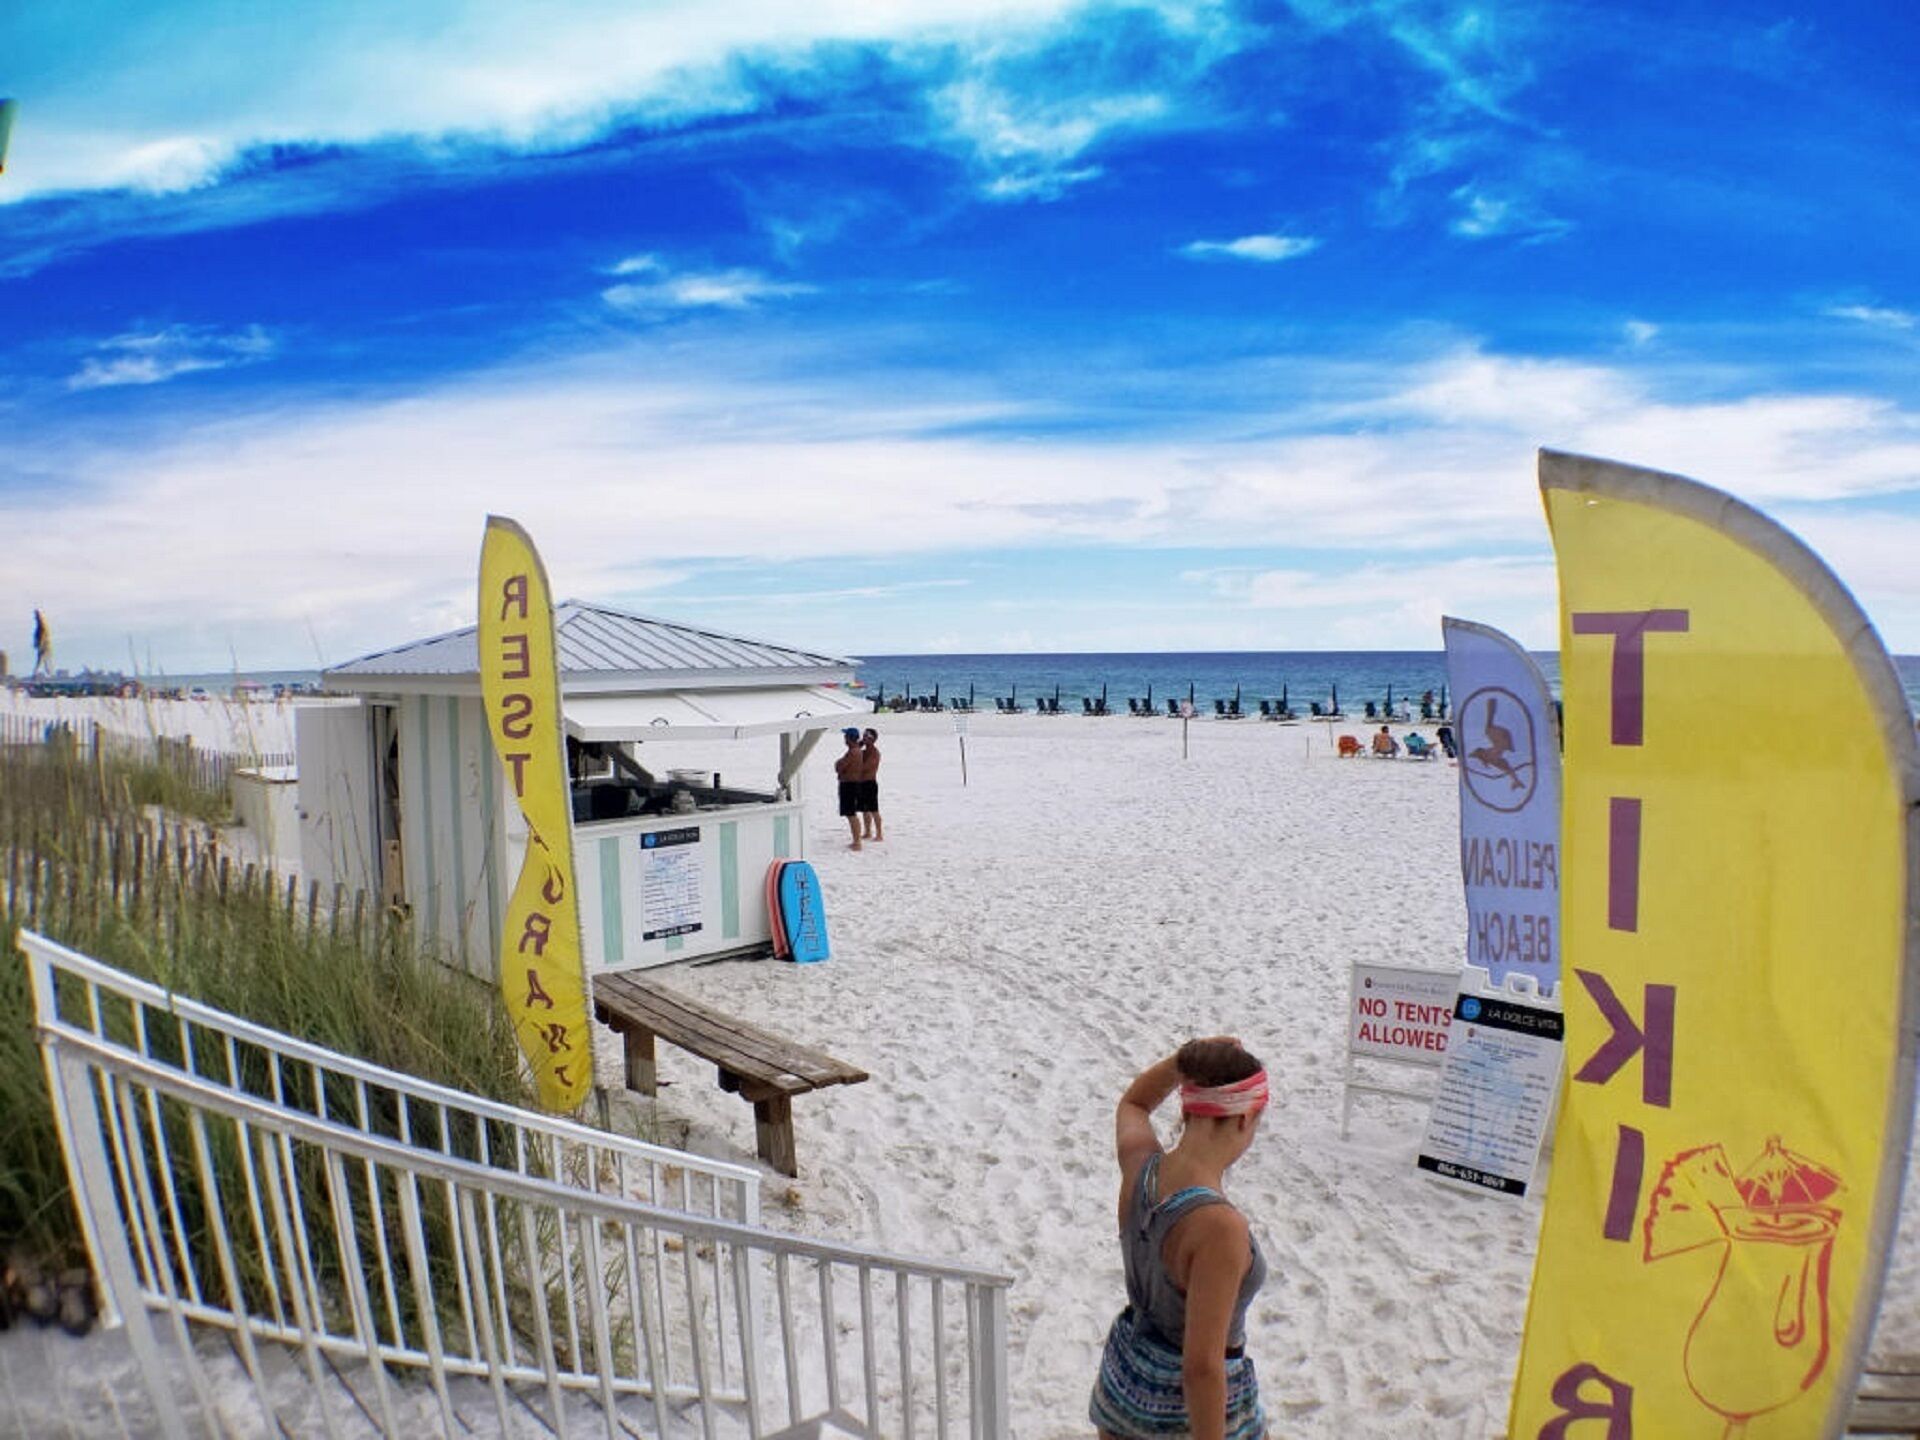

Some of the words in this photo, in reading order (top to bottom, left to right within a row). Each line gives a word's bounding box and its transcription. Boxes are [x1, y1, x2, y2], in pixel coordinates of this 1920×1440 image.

[1358, 997, 1387, 1017] NO
[1394, 1001, 1452, 1027] TENTS
[1358, 1021, 1449, 1052] ALLOWED
